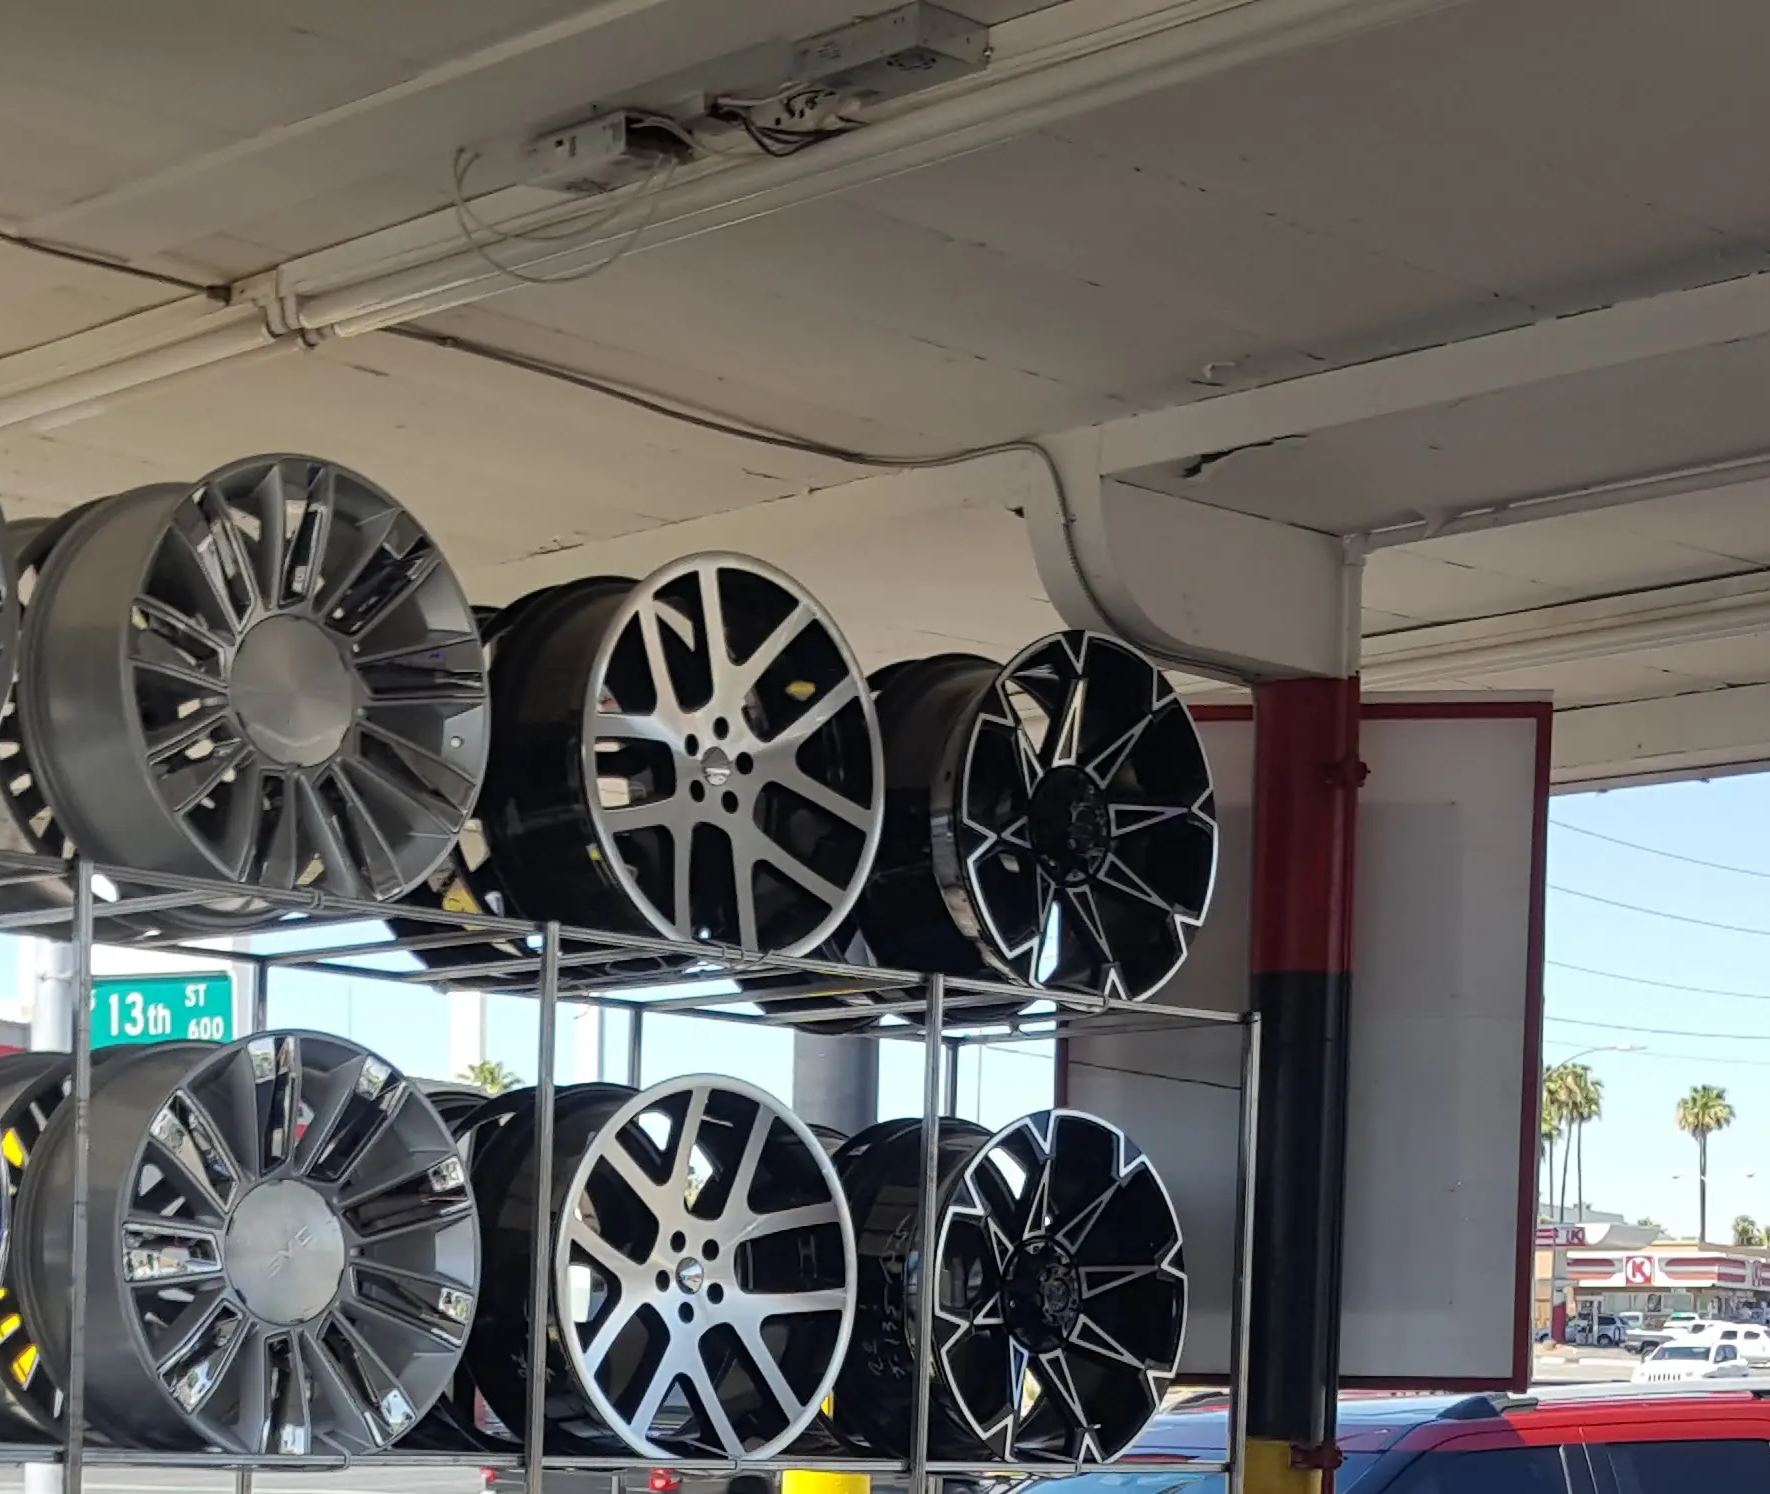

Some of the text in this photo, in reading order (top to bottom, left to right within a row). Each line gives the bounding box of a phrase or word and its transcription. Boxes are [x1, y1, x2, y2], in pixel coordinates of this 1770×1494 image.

[108, 991, 172, 1037] 13th
[184, 984, 208, 1008] ST
[187, 1016, 225, 1040] 600
